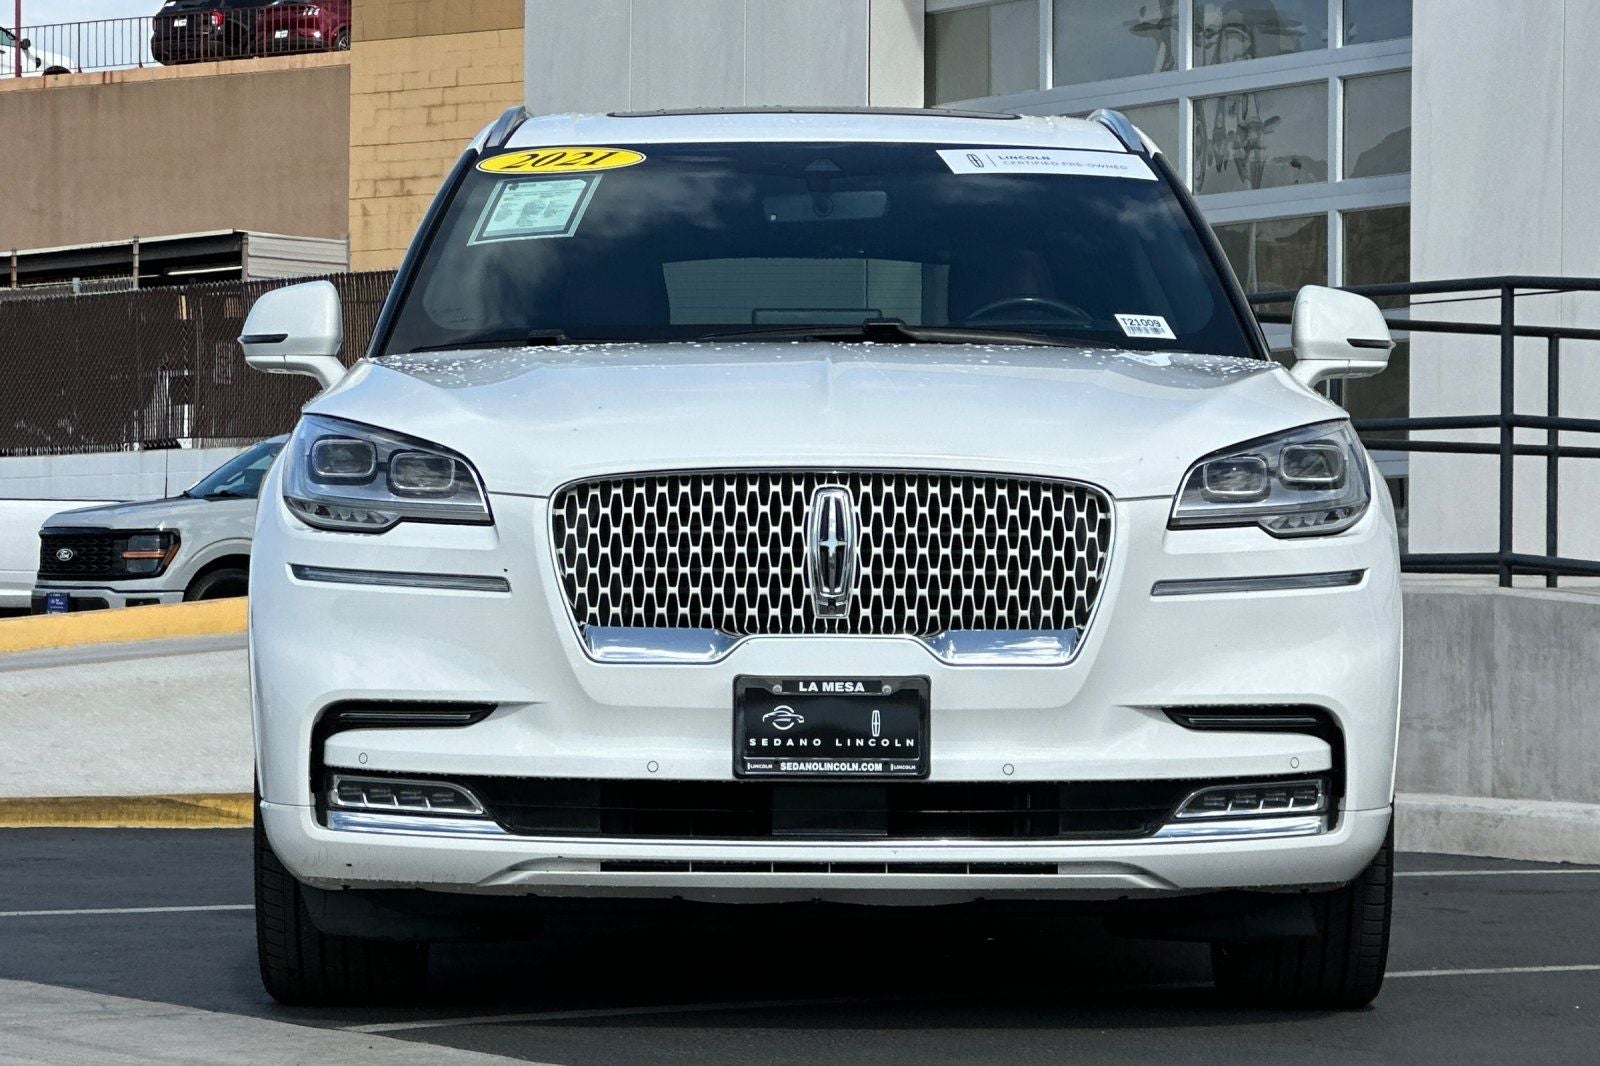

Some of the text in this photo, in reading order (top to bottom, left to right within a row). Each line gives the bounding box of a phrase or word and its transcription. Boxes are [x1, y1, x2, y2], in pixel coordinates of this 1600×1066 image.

[501, 151, 618, 169] 2021
[1061, 162, 1128, 170] PRE-OWNED
[1120, 317, 1161, 328] T21009
[799, 681, 865, 692] LA MESA
[749, 738, 915, 747] SEDANO LINCOLN
[780, 762, 883, 772] SEDANOLINCOLN.COM
